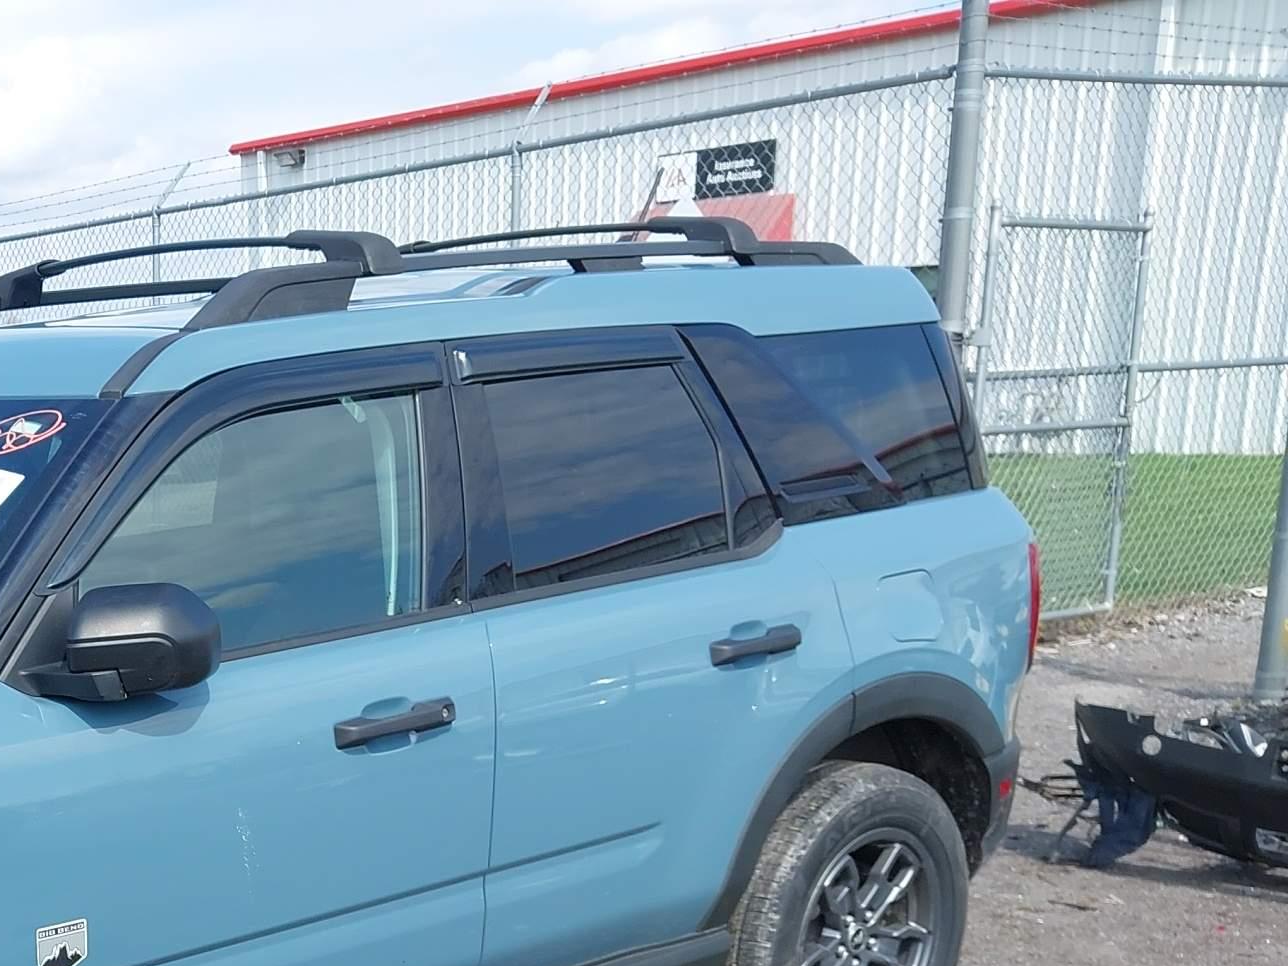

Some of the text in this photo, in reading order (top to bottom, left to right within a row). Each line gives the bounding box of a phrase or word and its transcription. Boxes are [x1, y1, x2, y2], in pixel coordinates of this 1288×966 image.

[714, 158, 755, 170] Insurance
[706, 169, 762, 184] Auto Auctions
